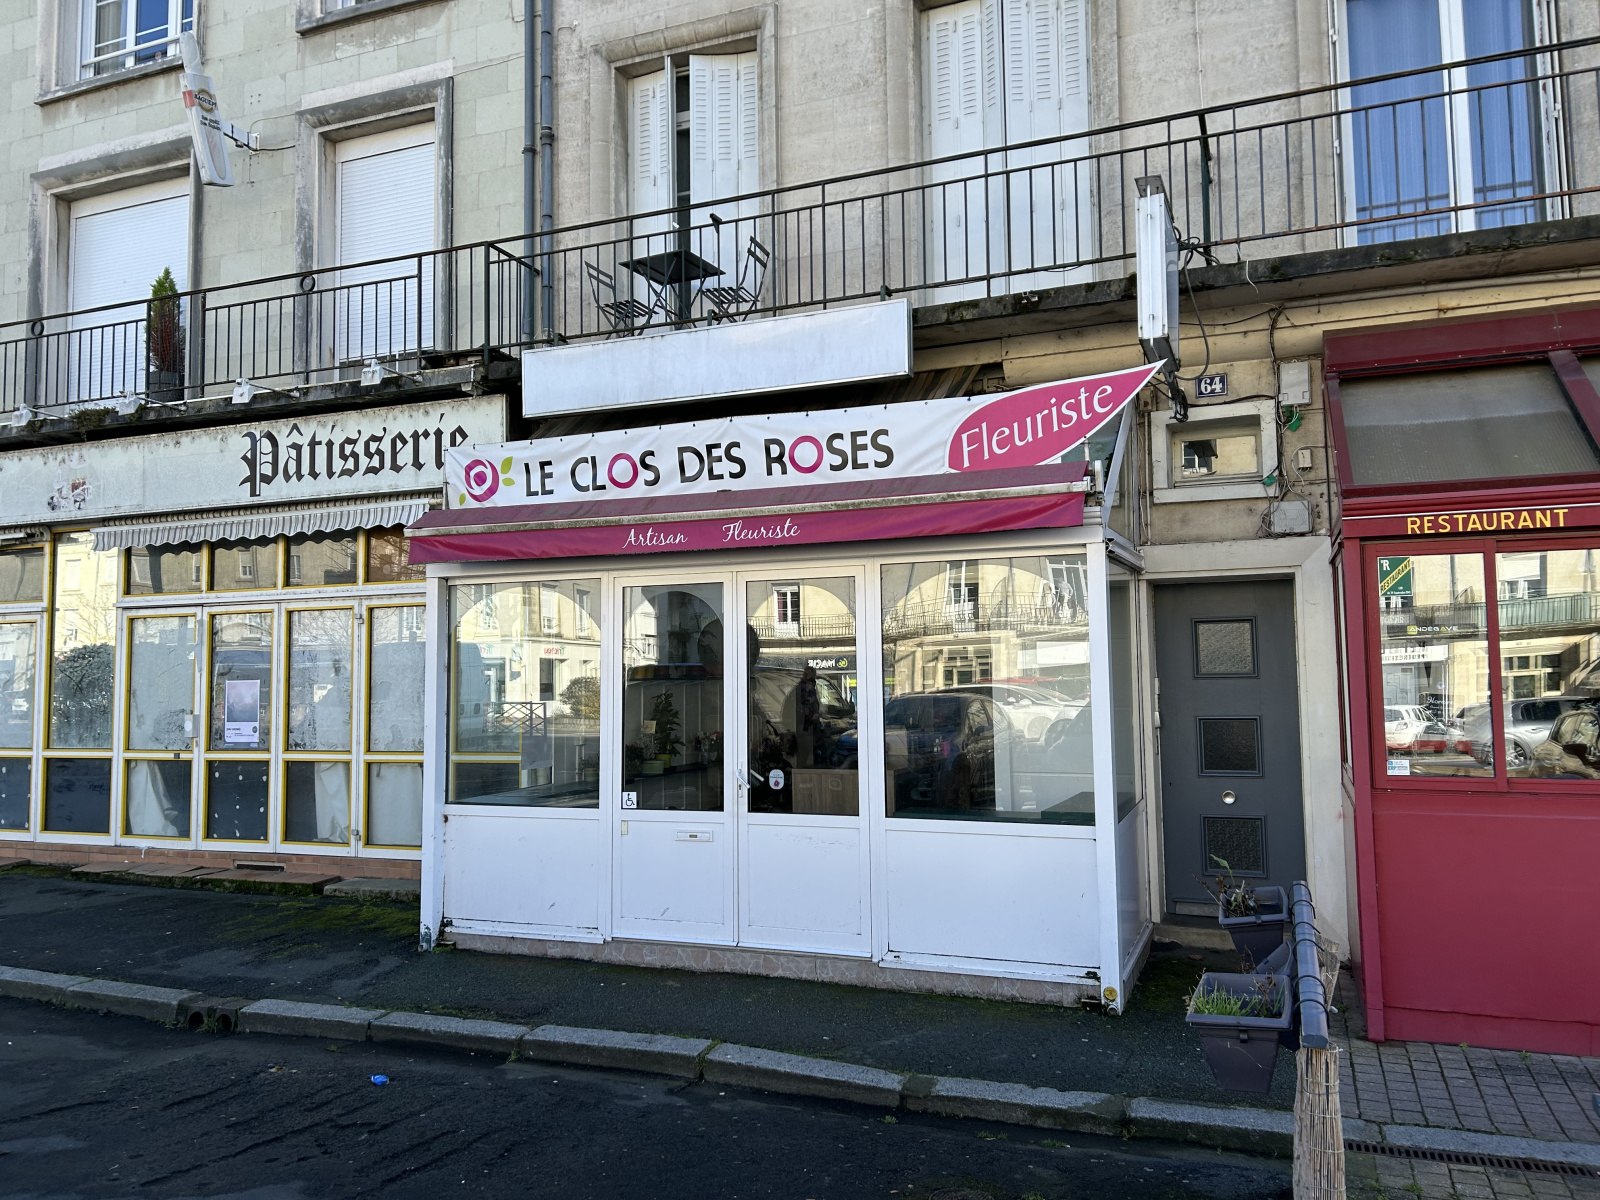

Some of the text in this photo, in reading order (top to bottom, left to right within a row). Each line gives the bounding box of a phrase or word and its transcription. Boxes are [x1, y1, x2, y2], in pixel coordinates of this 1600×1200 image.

[1200, 376, 1223, 393] 64
[961, 384, 1114, 468] Fleuriste
[524, 428, 895, 497] LE CLOS DES ROSES
[621, 517, 801, 549] Artisan Fleuriste
[1406, 508, 1569, 535] RESTAURANT
[1380, 559, 1411, 594] RESTAURANT
